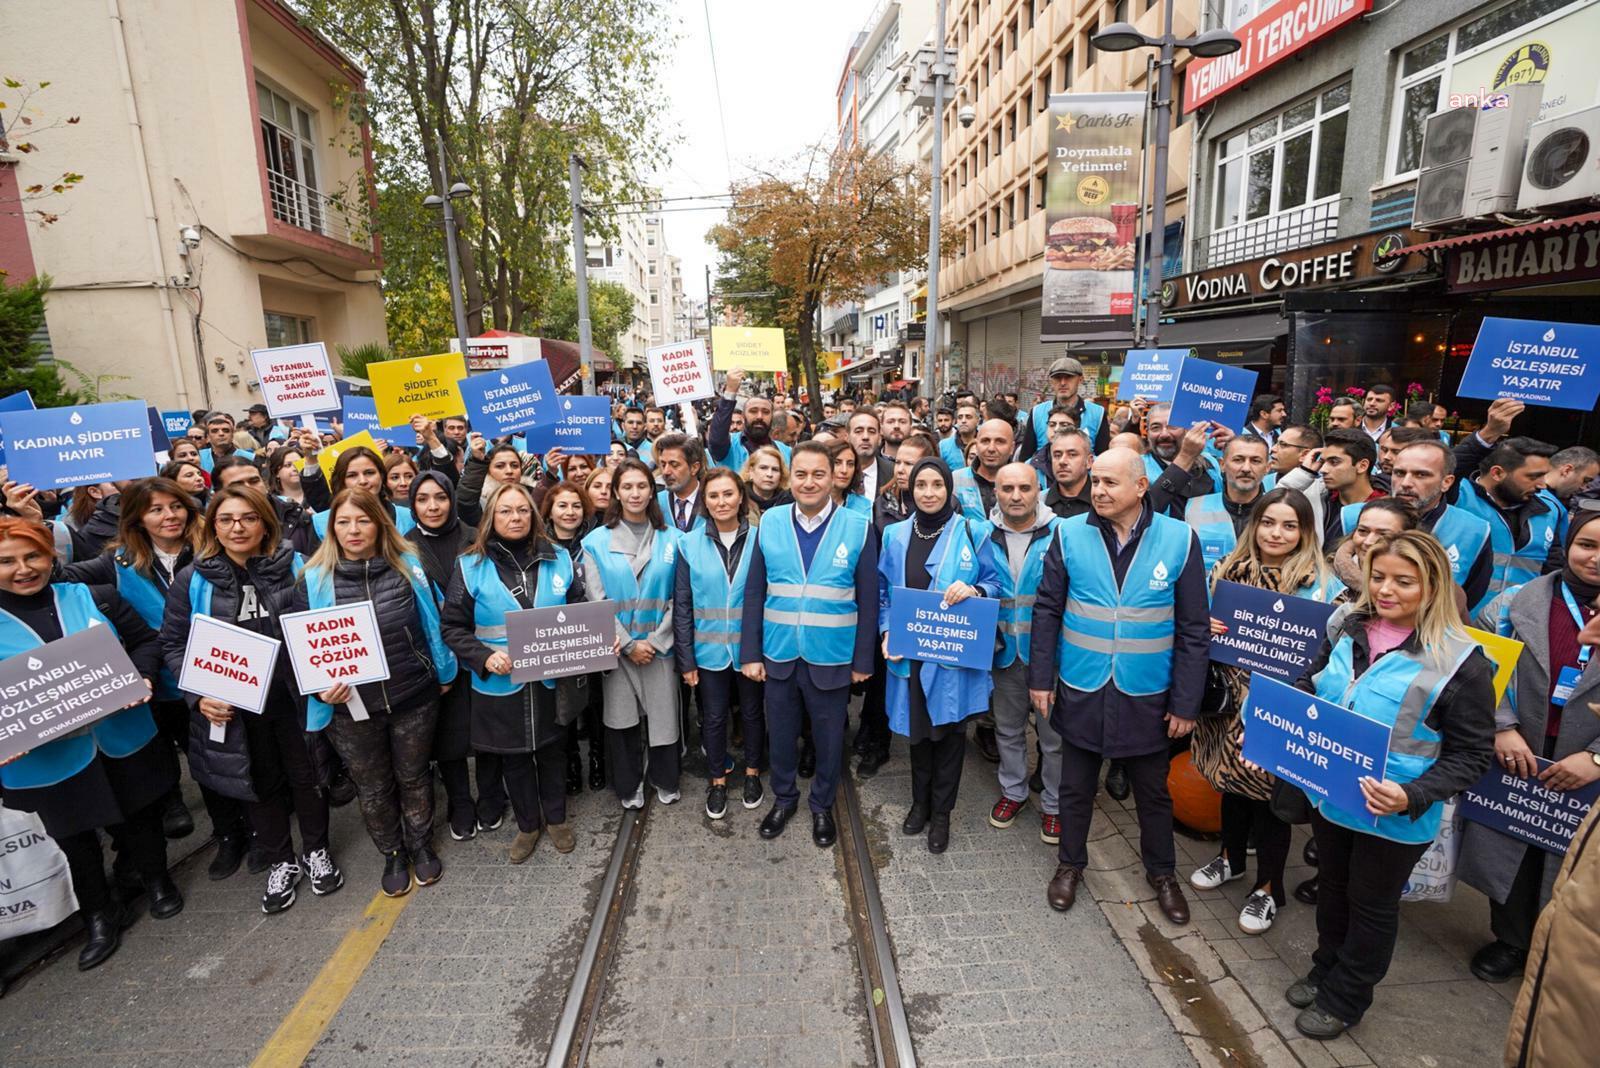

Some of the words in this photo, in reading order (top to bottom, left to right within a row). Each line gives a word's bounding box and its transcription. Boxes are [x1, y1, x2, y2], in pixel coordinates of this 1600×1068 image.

[1509, 67, 1532, 82] 1971
[1076, 113, 1112, 128] Carl's
[1114, 113, 1134, 128] Jr.
[1056, 146, 1132, 160] Doymakla
[1061, 160, 1128, 172] Yetinme!
[1456, 226, 1600, 284] BAHARİY
[1185, 272, 1247, 302] VODNA
[1260, 250, 1352, 290] COFFEE
[467, 346, 508, 358] Hürriyet
[662, 348, 693, 361] KADIN
[1507, 340, 1579, 359] İSTANBUL
[270, 362, 314, 373] İSTANBUL
[662, 360, 696, 373] VARSA
[1137, 363, 1170, 371] İSTANBUL
[1491, 357, 1586, 376] SÖZLEŞMESİ
[263, 369, 326, 384] SÖZLEŞMESİNE
[404, 378, 438, 392] ŞİDDET
[663, 371, 702, 386] ÇÖZÜM
[1130, 373, 1173, 382] SÖZLEŞMESİ
[1502, 375, 1562, 390] YAŞATIR
[284, 381, 310, 391] SAHİP
[484, 382, 532, 400] İSTANBUL
[674, 385, 695, 395] VAR
[1136, 383, 1163, 393] YAŞATIR
[1182, 382, 1213, 396] KADINA
[1214, 387, 1247, 403] ŞİDDETE
[277, 389, 326, 403] ÇIKACAĞIZ
[398, 389, 449, 404] ACİZLİKTİR
[482, 390, 542, 414] SÖZLEŞMESİ
[1498, 391, 1551, 402] #DEVAKADINDA
[1200, 400, 1224, 412] HAYIR
[496, 408, 536, 424] YAŞATIR
[567, 416, 605, 427] ŞİDDETE
[14, 435, 74, 450] KADINA
[78, 427, 142, 445] ŞİDDETE
[59, 447, 104, 462] HAYIR
[55, 472, 112, 484] #DEVAKADINDA
[306, 616, 355, 634] KADIN
[916, 608, 971, 626] İSTANBUL
[1234, 609, 1254, 623] BİR
[1256, 615, 1280, 630] KİŞİ
[1281, 622, 1317, 639] DAHA
[535, 624, 589, 638] İSTANBUL
[906, 622, 977, 640] SÖZLEŞMESİ
[1238, 626, 1306, 651] EKSİLMEYE
[308, 632, 361, 650] VARSA
[523, 633, 603, 654] SÖZLEŞMESİNİ
[917, 638, 964, 652] YAŞATIR
[1211, 634, 1304, 666] AHAMMÜLÜMÜZ
[210, 647, 249, 668] DEVA
[309, 647, 368, 668] ÇÖZÜM
[513, 656, 540, 668] GERİ
[543, 646, 614, 665] GETİRECEĞİZ
[194, 657, 259, 687] KADINDA
[326, 664, 359, 679] VAR
[544, 665, 585, 676] #DEVAKADINDA
[1238, 657, 1289, 676] #DEVAKADINDA
[0, 660, 87, 700] İSTANBUL
[0, 663, 114, 720] ÖZLEŞMESİNİ
[29, 672, 138, 726] GETİRECEĞİZ
[38, 706, 103, 739] #DEVAKADINDA
[1254, 706, 1304, 739] KADINA
[1308, 730, 1374, 770] ŞİDDETE
[1286, 740, 1329, 770] HAYIR
[1276, 765, 1329, 796] #DEVAKADINDA
[1501, 774, 1528, 792] BİR
[1532, 786, 1565, 804] KİŞİ
[1465, 791, 1577, 840] TAHAMMÜLÜM
[1507, 792, 1584, 826] EKSİLME
[1508, 825, 1570, 852] #DEVAKADIN
